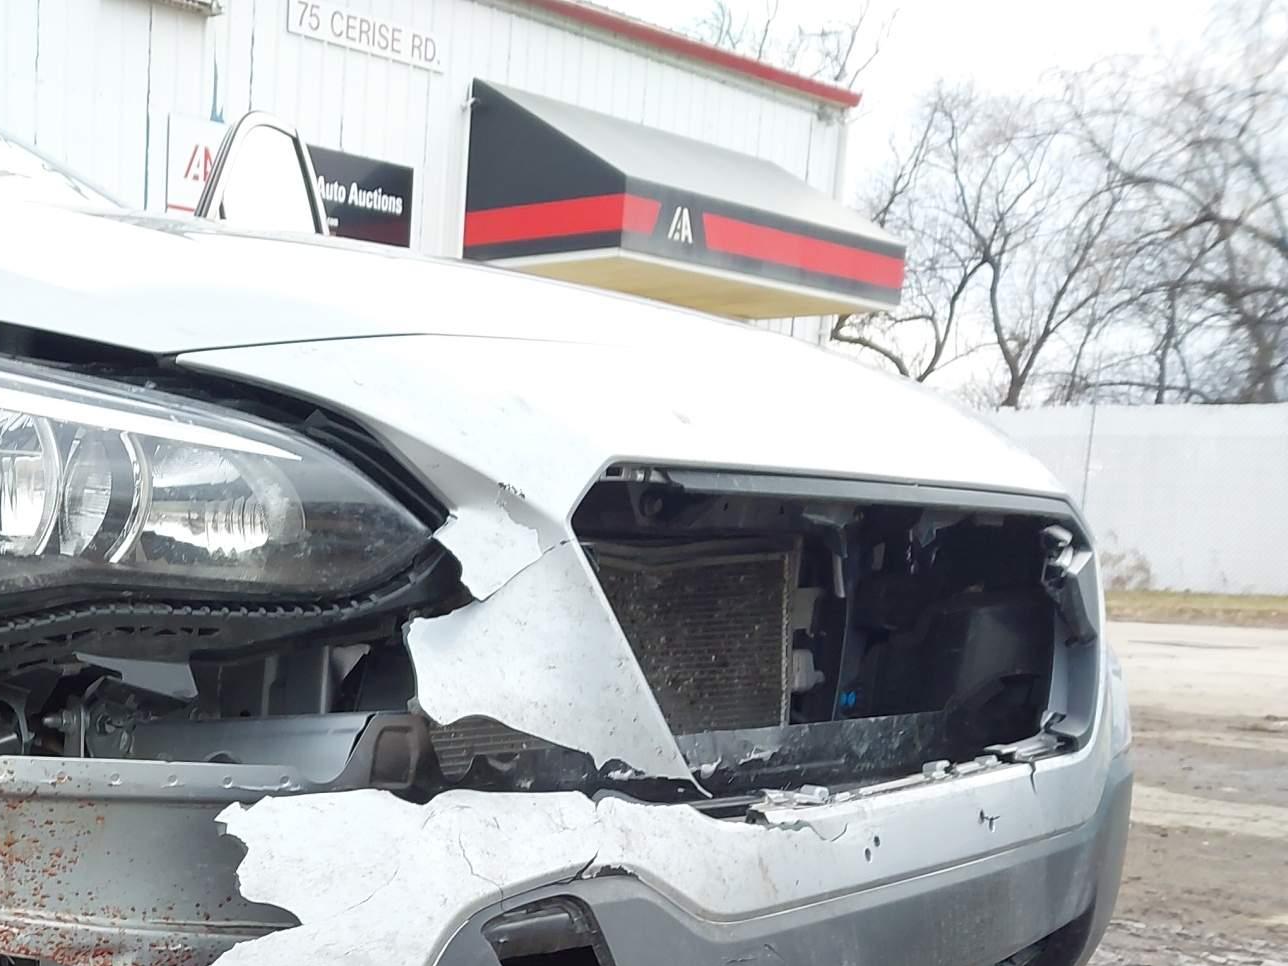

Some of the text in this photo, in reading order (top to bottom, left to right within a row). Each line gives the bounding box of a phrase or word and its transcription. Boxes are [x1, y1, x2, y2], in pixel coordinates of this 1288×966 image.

[297, 1, 441, 66] 75 CERISE RD.
[316, 175, 404, 216] Auto Auctions
